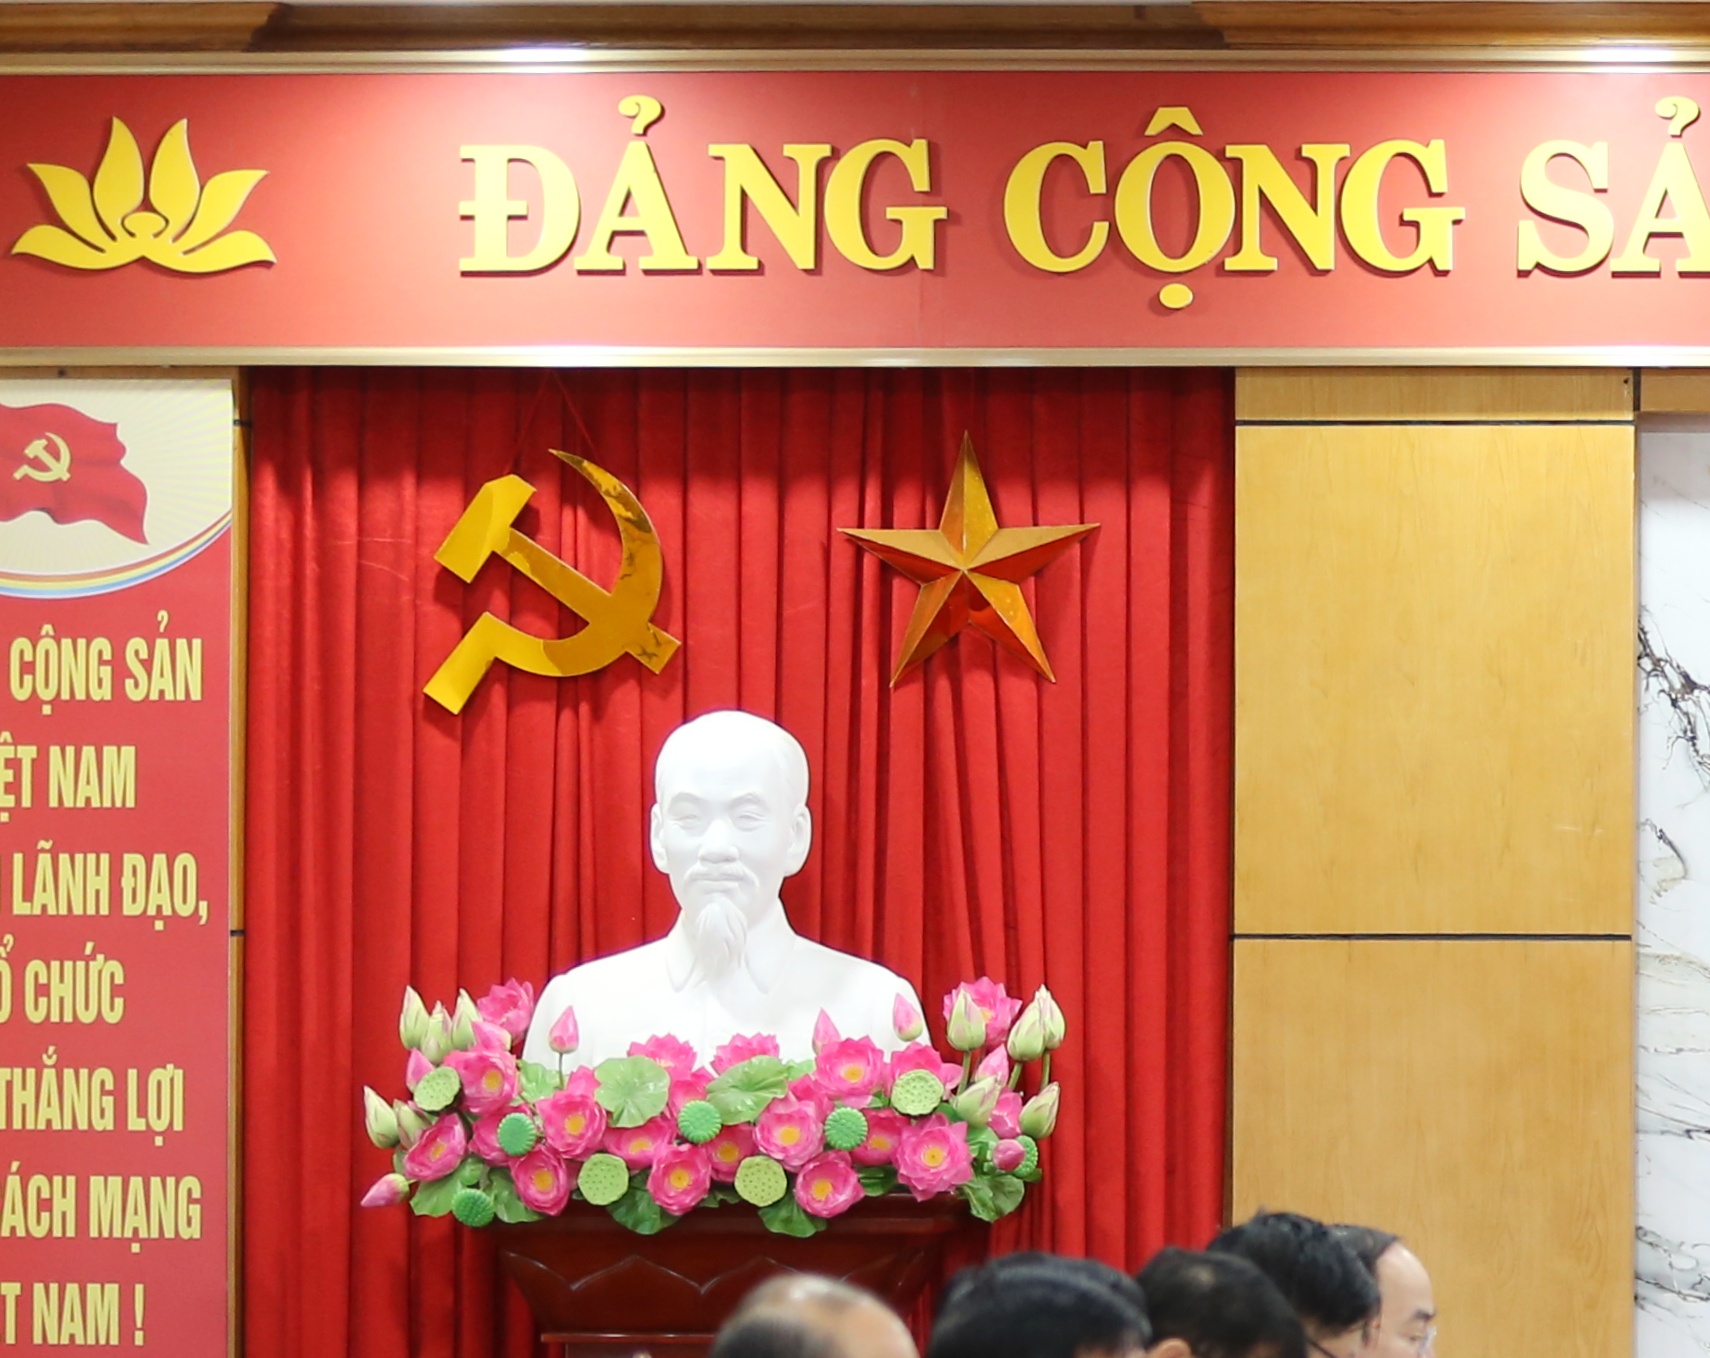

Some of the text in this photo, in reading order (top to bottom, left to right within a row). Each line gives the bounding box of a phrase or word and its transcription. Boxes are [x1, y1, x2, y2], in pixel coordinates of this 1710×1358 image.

[458, 95, 947, 271] ĐẢNG
[1004, 108, 1466, 308] CỘNG
[11, 612, 202, 713] CỘNG SẢN
[50, 746, 135, 807] NAM
[13, 841, 208, 929] LÃNH ĐẠO,
[25, 943, 124, 1023] CHỨC
[128, 1066, 183, 1144] LỢI
[90, 1176, 201, 1251] MẠNG
[34, 1284, 119, 1344] NAM
